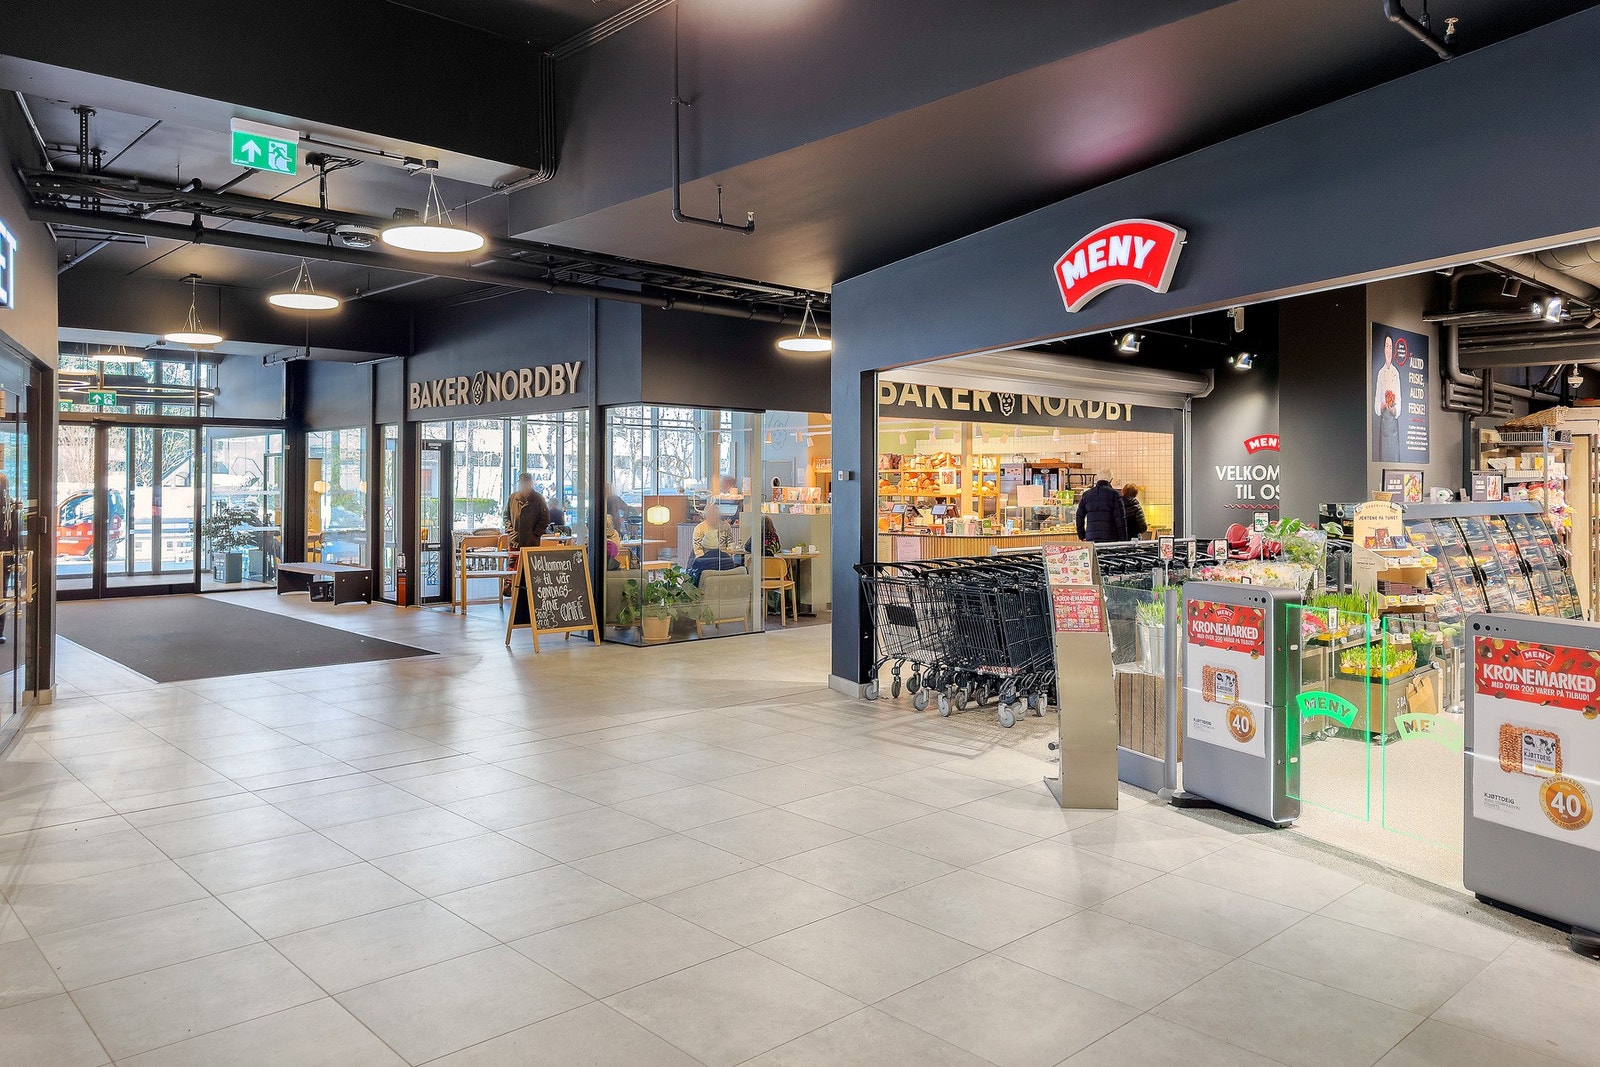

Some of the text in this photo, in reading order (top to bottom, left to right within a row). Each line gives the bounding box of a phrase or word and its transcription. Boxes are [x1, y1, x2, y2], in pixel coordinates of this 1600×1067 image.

[1061, 235, 1156, 290] MENY
[410, 361, 582, 410] BAKER NORDBY
[1235, 484, 1256, 500] TIL
[530, 555, 572, 572] Velkommen
[543, 572, 553, 585] til
[1192, 620, 1258, 640] KRONEMARKED
[1525, 650, 1552, 661] MENY
[1483, 664, 1597, 693] KRONEMARKED
[1491, 681, 1590, 701] MED OVER 200 VARER PÅ TILBUD!
[1304, 697, 1350, 717] MENY
[1232, 715, 1250, 733] 40
[1550, 791, 1581, 818] 40
